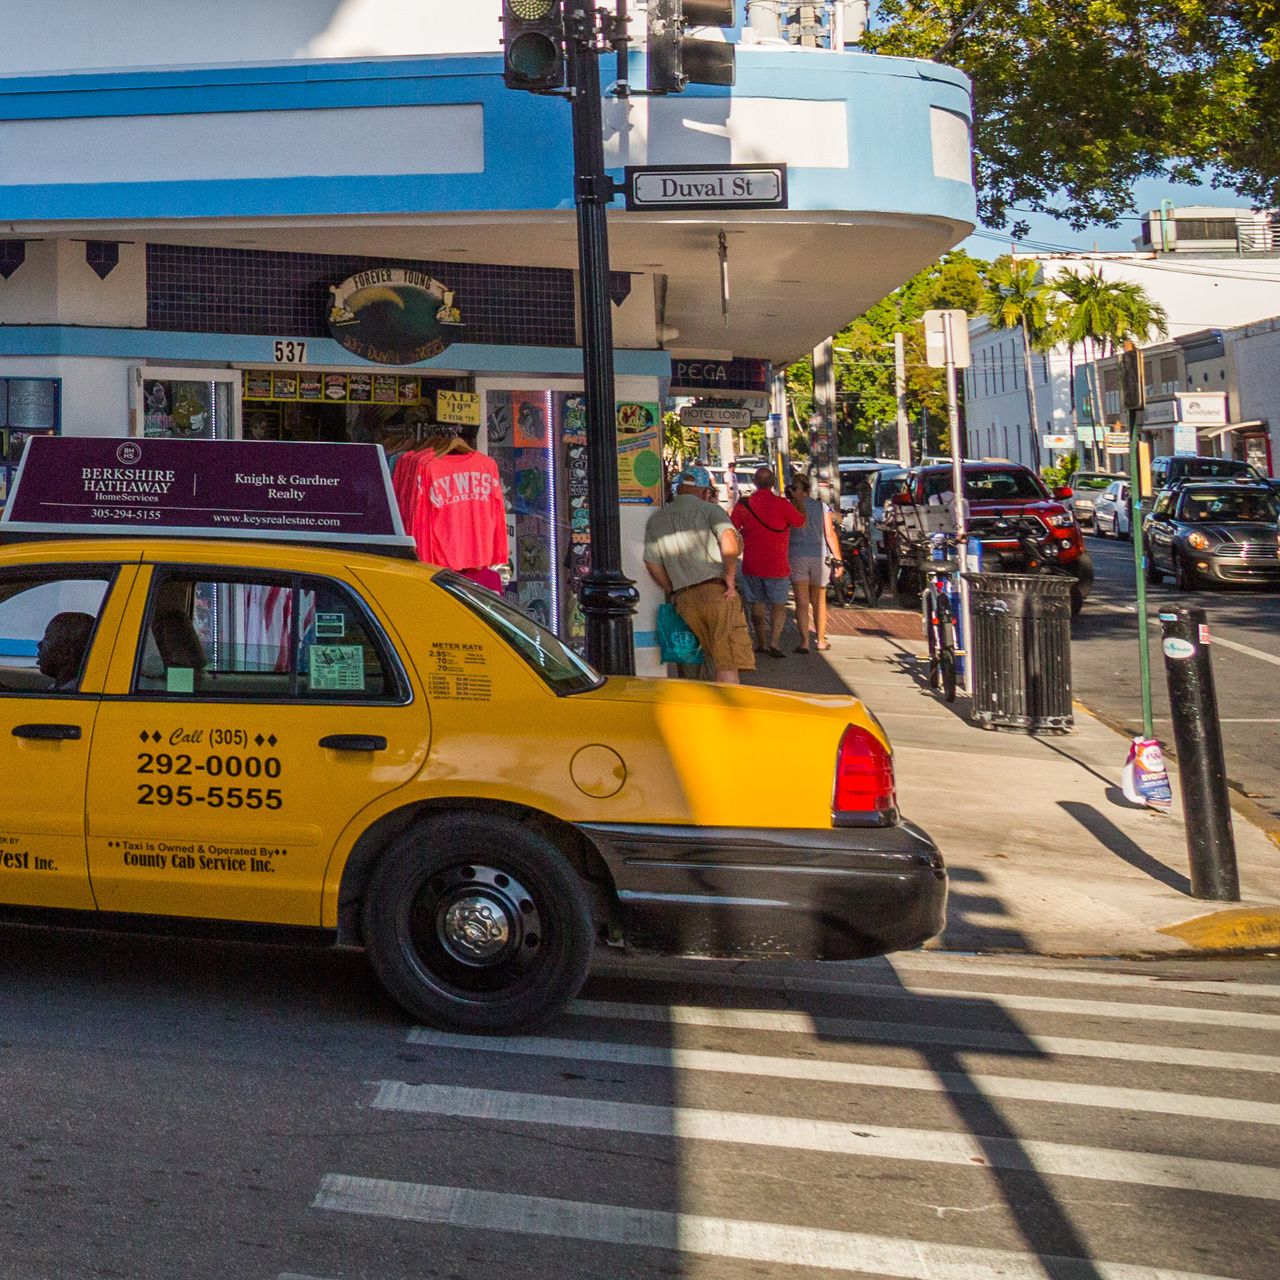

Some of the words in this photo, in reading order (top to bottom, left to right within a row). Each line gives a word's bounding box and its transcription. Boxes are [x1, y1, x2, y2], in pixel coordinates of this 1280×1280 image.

[661, 178, 725, 198] Duval
[733, 177, 753, 197] St
[353, 269, 392, 290] FOREVER
[403, 270, 431, 290] YOUNG
[275, 340, 306, 363] 537
[438, 391, 480, 404] SALE
[684, 410, 714, 420] HOTEL
[719, 410, 746, 420] LOBBY
[82, 468, 175, 482] BERKSHIRE
[235, 473, 274, 487] Knight
[278, 475, 287, 485] &
[290, 474, 340, 486] Gardner
[83, 480, 171, 494] HATHAWAY
[268, 487, 306, 501] Realty
[95, 493, 159, 503] HomeServices
[91, 508, 161, 520] 305-294-5155
[213, 513, 340, 526] www.keysrealestate.com
[432, 642, 460, 650] METER
[462, 643, 483, 651] RATE
[435, 664, 448, 672] .70
[169, 727, 204, 746] Call
[209, 728, 248, 748] (305)
[137, 753, 281, 778] 292-0000
[137, 784, 283, 810] 295-5555
[122, 841, 143, 850] Taxi
[158, 843, 195, 854] Owned
[197, 845, 205, 854] &
[208, 845, 257, 857] Operated
[260, 848, 274, 858] By
[34, 856, 58, 871] Inc.
[124, 851, 167, 870] County
[171, 853, 196, 870] Cab
[199, 855, 247, 872] Service
[251, 857, 276, 873] Inc.
